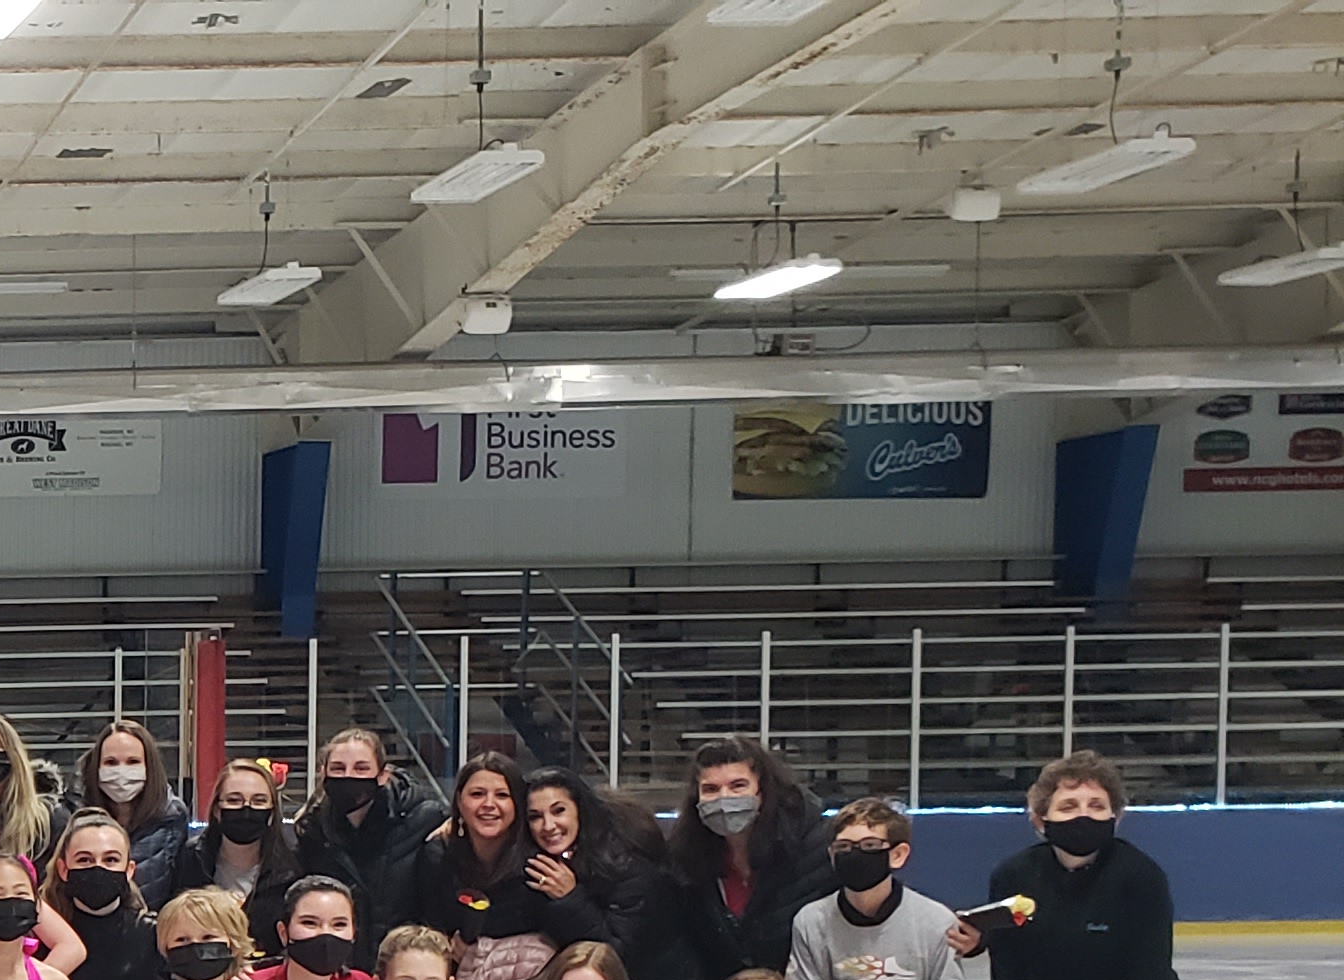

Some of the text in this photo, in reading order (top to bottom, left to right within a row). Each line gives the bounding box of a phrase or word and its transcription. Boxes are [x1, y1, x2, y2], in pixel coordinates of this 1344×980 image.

[846, 402, 983, 426] DELICIOUS
[486, 422, 616, 449] Business
[866, 432, 962, 480] Culver's
